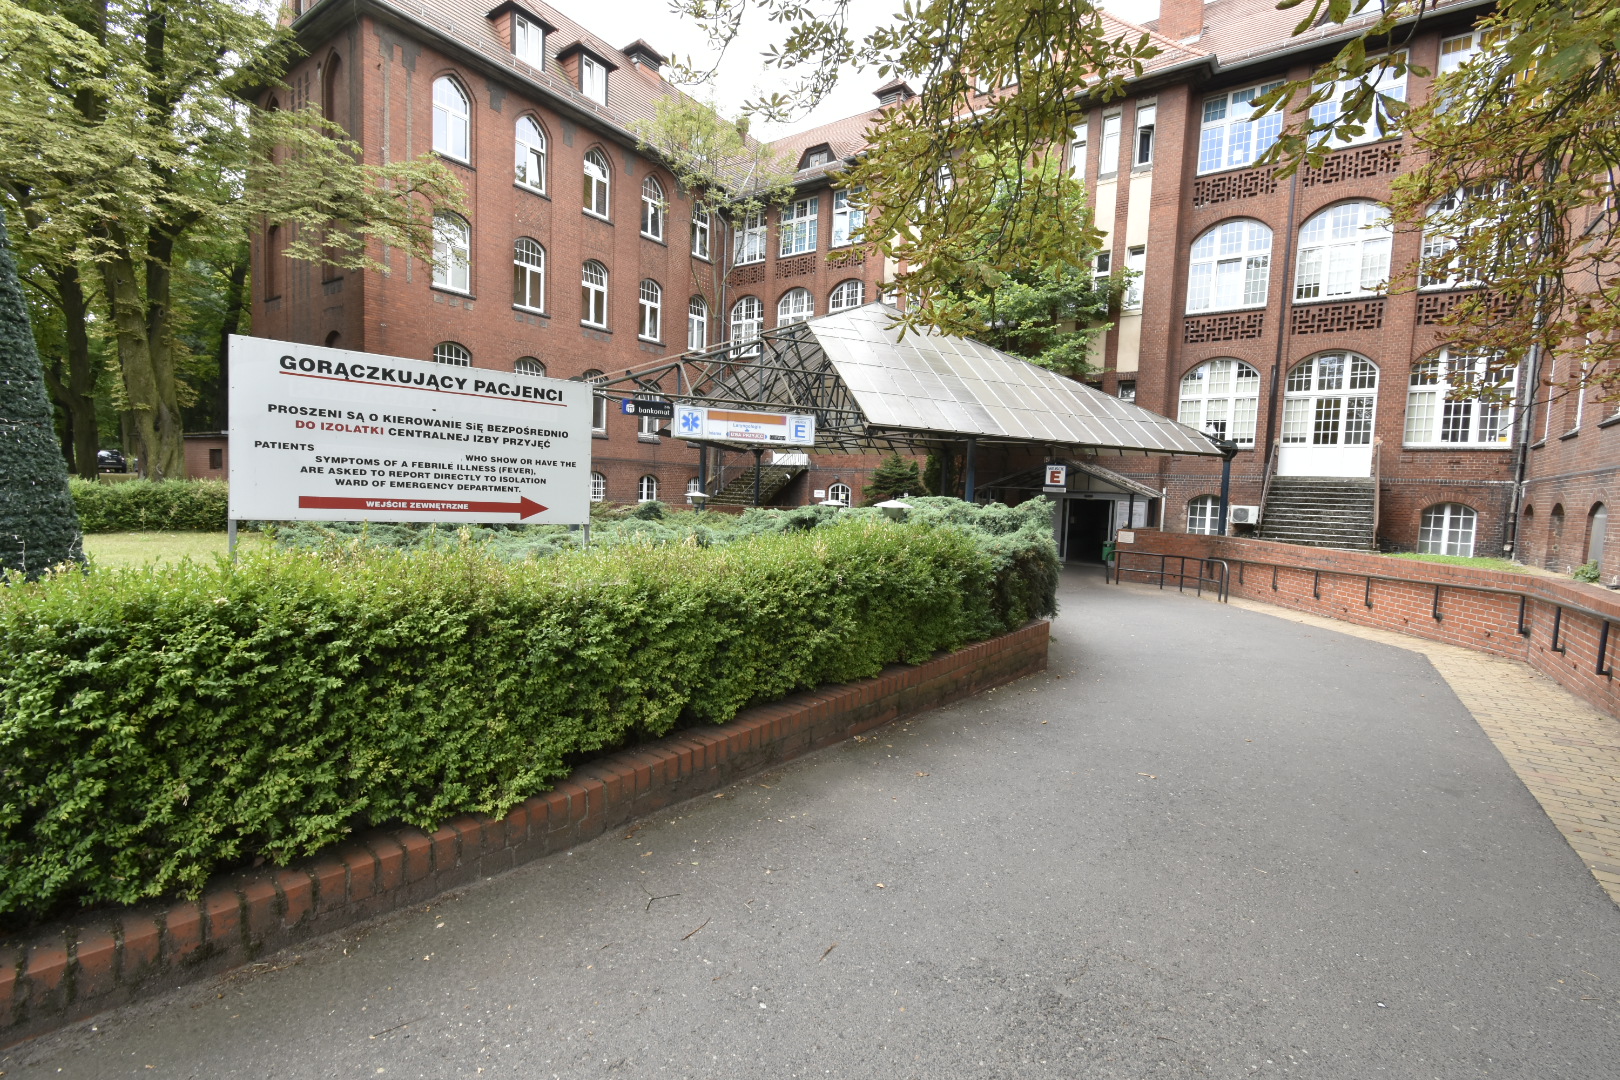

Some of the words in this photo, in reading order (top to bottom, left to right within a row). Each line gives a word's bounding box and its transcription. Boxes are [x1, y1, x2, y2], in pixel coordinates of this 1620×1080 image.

[280, 356, 467, 391] GORĄCZKUJĄCY
[474, 380, 562, 401] PACJENCI
[638, 406, 670, 416] bankomat
[268, 404, 341, 418] PROSZENI
[347, 412, 364, 422] SĄ
[383, 415, 461, 429] KIEROWANIE
[487, 425, 568, 438] BEZPOŚREDNIO
[296, 420, 315, 429] DO
[321, 423, 383, 435] IZOLATKI
[388, 428, 469, 441] CENTRALNEJ
[474, 431, 498, 443] IZBY
[503, 434, 550, 449] PRZYJĘĆ
[795, 425, 805, 438] E
[254, 441, 315, 451] PATIENTS
[316, 456, 379, 466] SYMPTOMS
[457, 464, 495, 472] ILLNESS
[499, 467, 536, 476] (FEVER),
[434, 473, 480, 481] DIRECTLY
[1050, 470, 1061, 483] E
[390, 481, 453, 489] EMERGENCY
[457, 484, 520, 492] DEPARTMENT.
[366, 500, 407, 508] WEJŚCIE
[410, 502, 468, 510] ZEWNĘTRZNE
